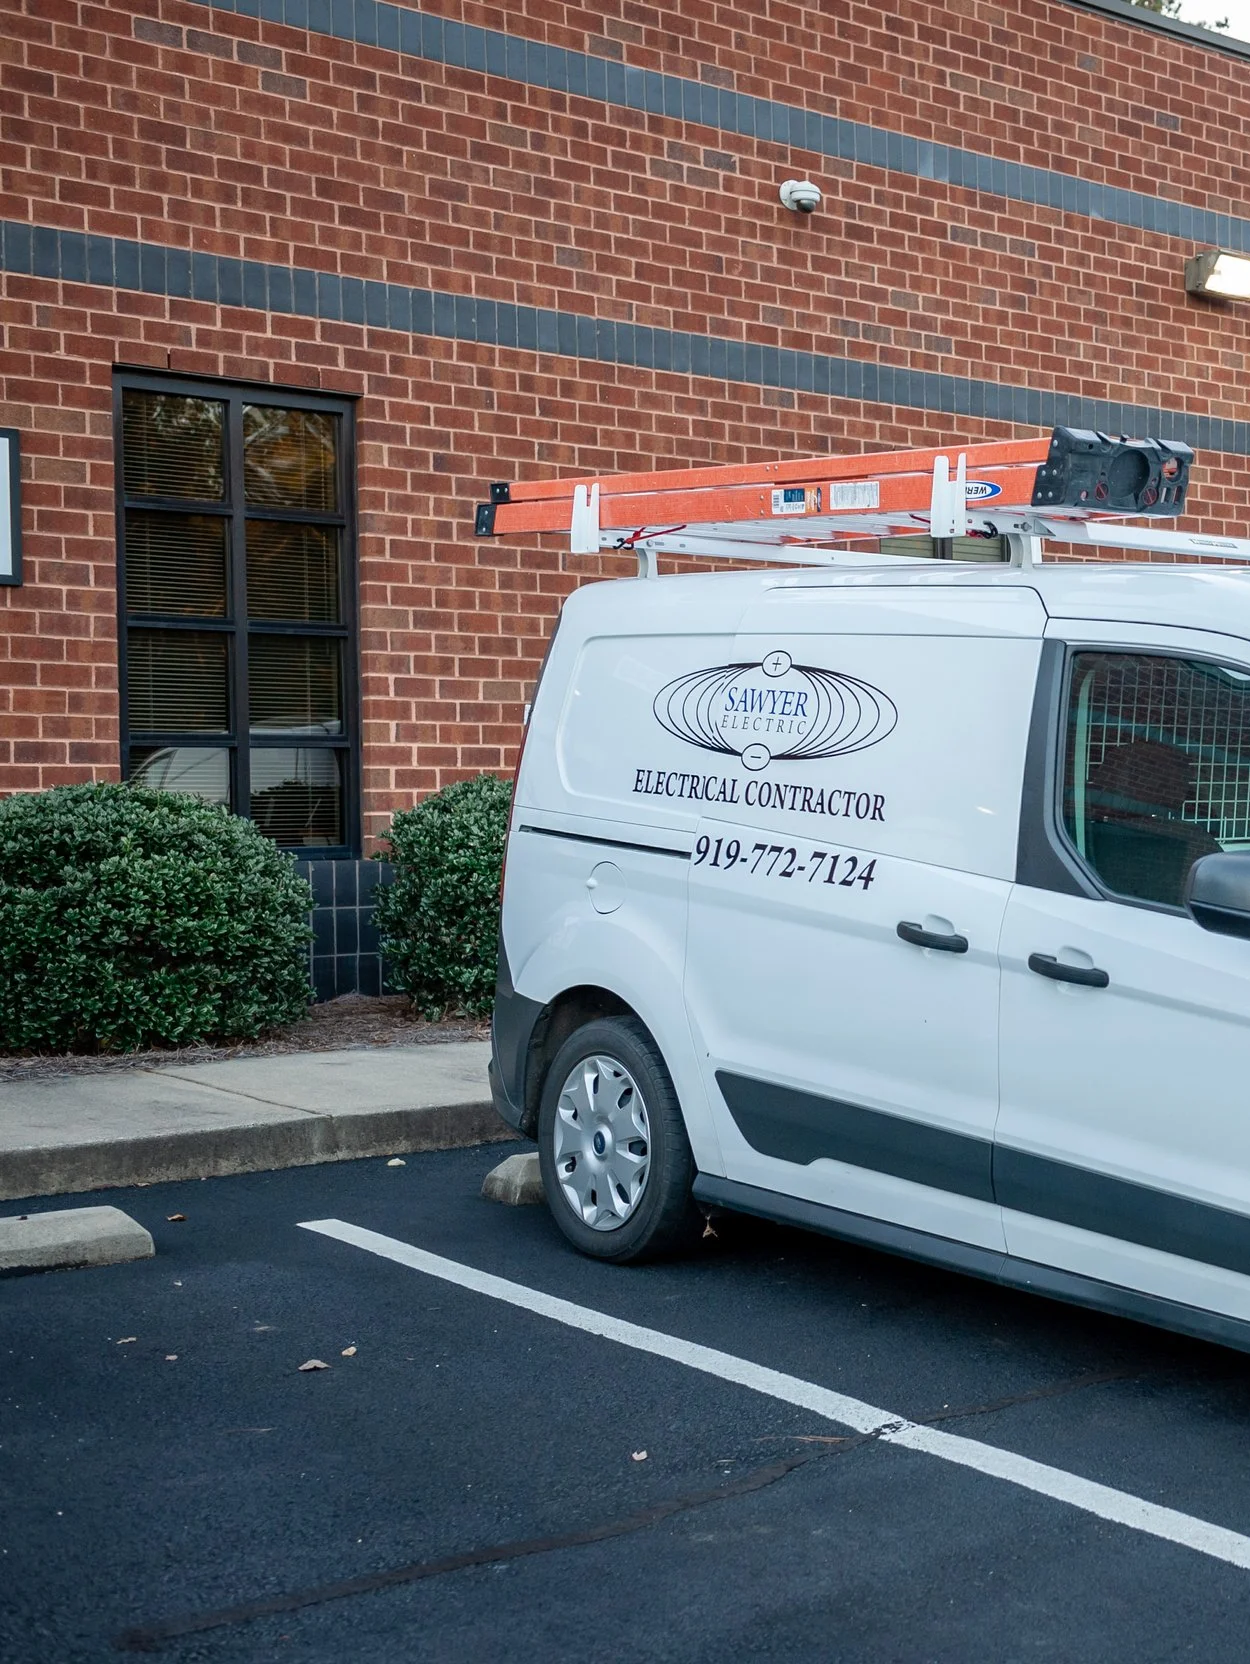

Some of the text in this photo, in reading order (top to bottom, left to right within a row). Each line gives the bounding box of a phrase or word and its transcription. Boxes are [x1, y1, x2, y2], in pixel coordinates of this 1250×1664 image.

[965, 486, 987, 495] WER
[724, 686, 808, 717] SAWYER
[721, 714, 807, 735] ELECTRIC
[632, 769, 886, 821] ELECTRICAL CONTRACTOR
[694, 835, 878, 890] 919-772-7124
